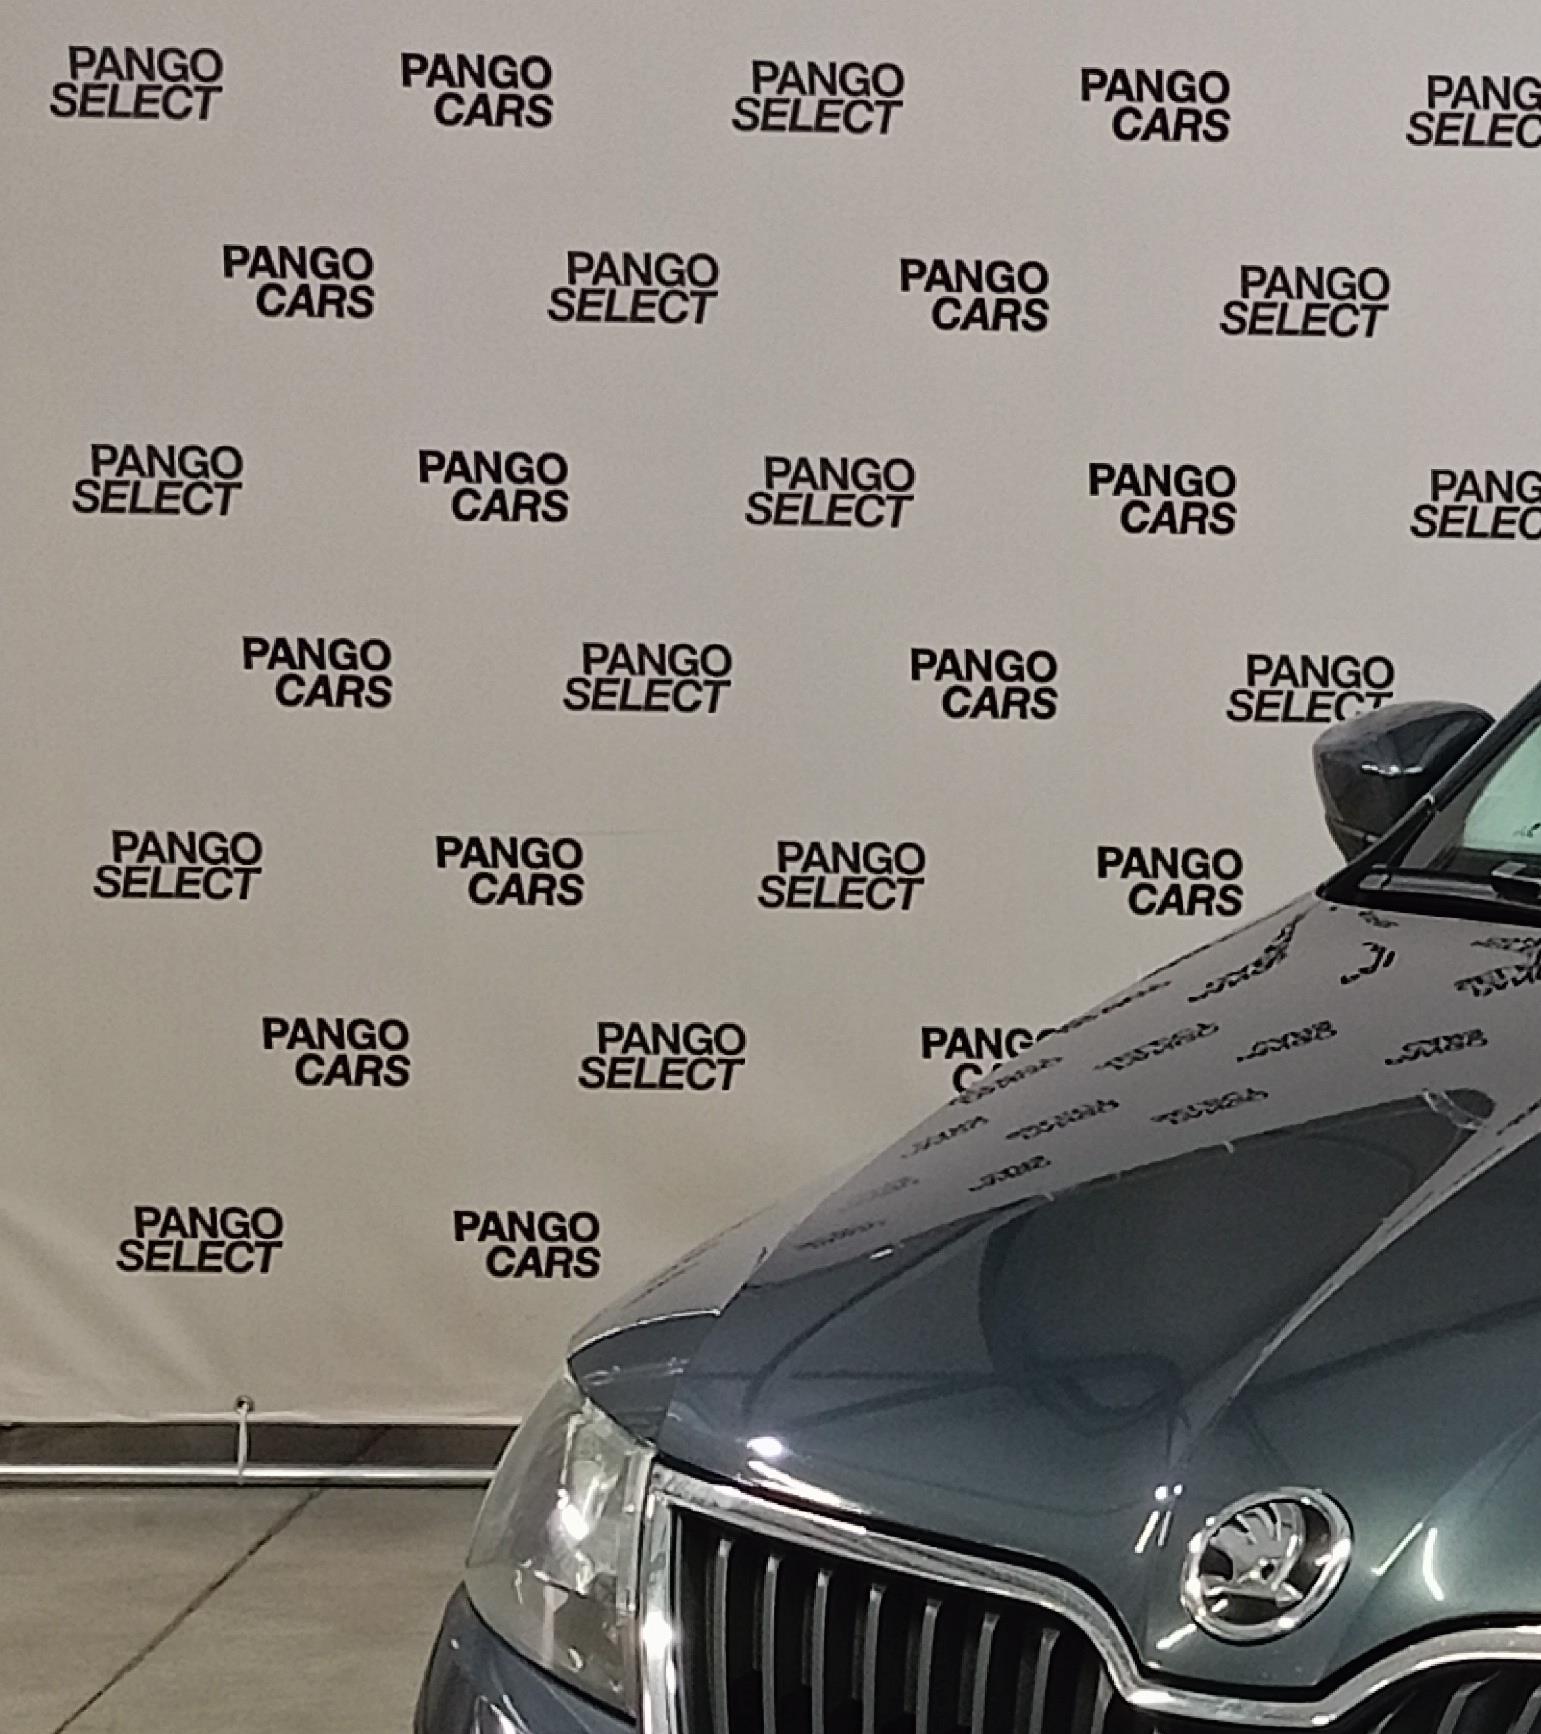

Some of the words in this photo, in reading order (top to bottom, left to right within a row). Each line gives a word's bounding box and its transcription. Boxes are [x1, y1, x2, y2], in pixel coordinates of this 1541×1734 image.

[69, 46, 223, 83] PANGO
[401, 52, 552, 90] PANGO
[753, 60, 904, 98] PANGO
[50, 82, 223, 121] SELECT
[1081, 67, 1230, 105] PANGO
[434, 92, 553, 128] CARS
[732, 96, 903, 134] SELECT
[1112, 106, 1231, 142] CARS
[223, 244, 374, 281] PANGO
[568, 251, 718, 288] PANGO
[901, 258, 1049, 294] PANGO
[257, 282, 374, 319] CARS
[1241, 265, 1390, 301] PANGO
[547, 287, 718, 324] SELECT
[932, 296, 1049, 332] CARS
[1220, 301, 1389, 338] SELECT
[91, 444, 243, 480] PANGO
[419, 449, 568, 486] PANGO
[764, 456, 914, 492] PANGO
[1089, 463, 1237, 497] PANGO
[72, 479, 243, 516] SELECT
[451, 488, 568, 522] CARS
[745, 492, 914, 528] SELECT
[1120, 499, 1237, 535] CARS
[243, 636, 391, 671] PANGO
[583, 642, 732, 678] PANGO
[911, 648, 1057, 683] PANGO
[1247, 654, 1395, 690] PANGO
[276, 673, 392, 708] CARS
[563, 677, 731, 713] SELECT
[943, 684, 1058, 720] CARS
[112, 830, 262, 865] PANGO
[436, 836, 583, 870] PANGO
[778, 840, 925, 876] PANGO
[1098, 846, 1243, 880] PANGO
[93, 865, 262, 900] SELECT
[468, 872, 584, 906] CARS
[758, 875, 925, 911] SELECT
[1128, 882, 1243, 916] CARS
[262, 1016, 409, 1051] PANGO
[597, 1022, 746, 1055] PANGO
[922, 1026, 1053, 1059] PANG
[295, 1053, 410, 1087] CARS
[578, 1056, 745, 1090] SELECT
[134, 1206, 283, 1239] PANGO
[453, 1210, 599, 1243] PANGO
[116, 1239, 283, 1274] SELECT
[486, 1245, 601, 1278] CARS
